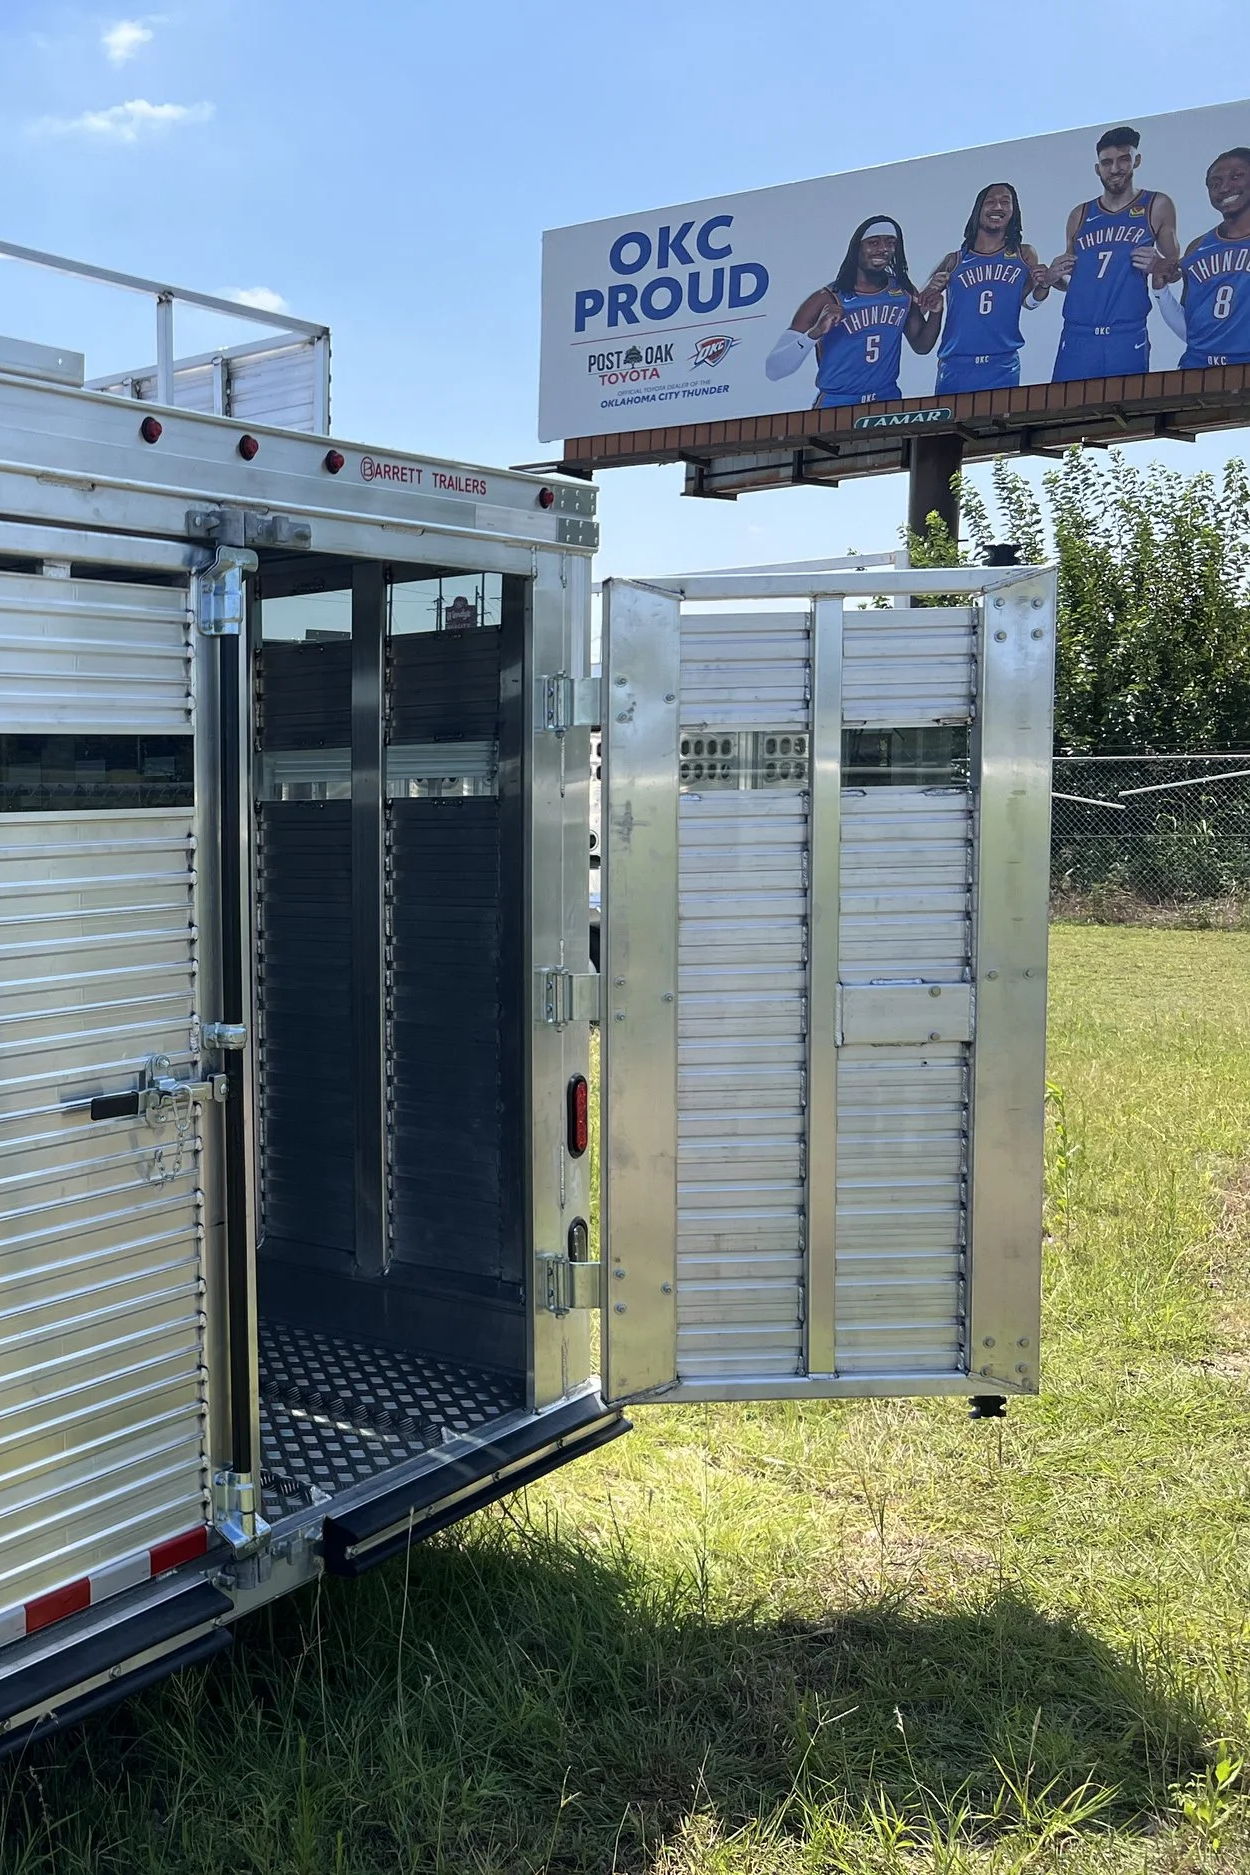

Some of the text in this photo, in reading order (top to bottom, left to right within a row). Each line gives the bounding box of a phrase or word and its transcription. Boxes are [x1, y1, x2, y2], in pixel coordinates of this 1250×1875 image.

[610, 215, 734, 276] OKC
[1078, 226, 1145, 250] THUNDER
[958, 264, 1022, 288] THUNDER
[1097, 251, 1112, 278] 7
[574, 262, 770, 332] PROUD
[980, 290, 992, 314] 6
[1214, 286, 1233, 318] 8
[841, 306, 905, 334] THUNDER
[1094, 327, 1110, 335] OKC
[588, 344, 674, 372] POST OAK
[866, 335, 880, 362] 5
[975, 355, 990, 364] OKC
[1208, 356, 1226, 366] OKC
[599, 368, 660, 386] TOYOTA
[618, 388, 642, 396] OFFICIAL
[644, 385, 666, 394] TOYOTA
[667, 382, 688, 390] DEALER
[600, 384, 730, 408] OKLAHOMA CITY THUNDER
[360, 456, 487, 495] BARRETT TRAILERS
